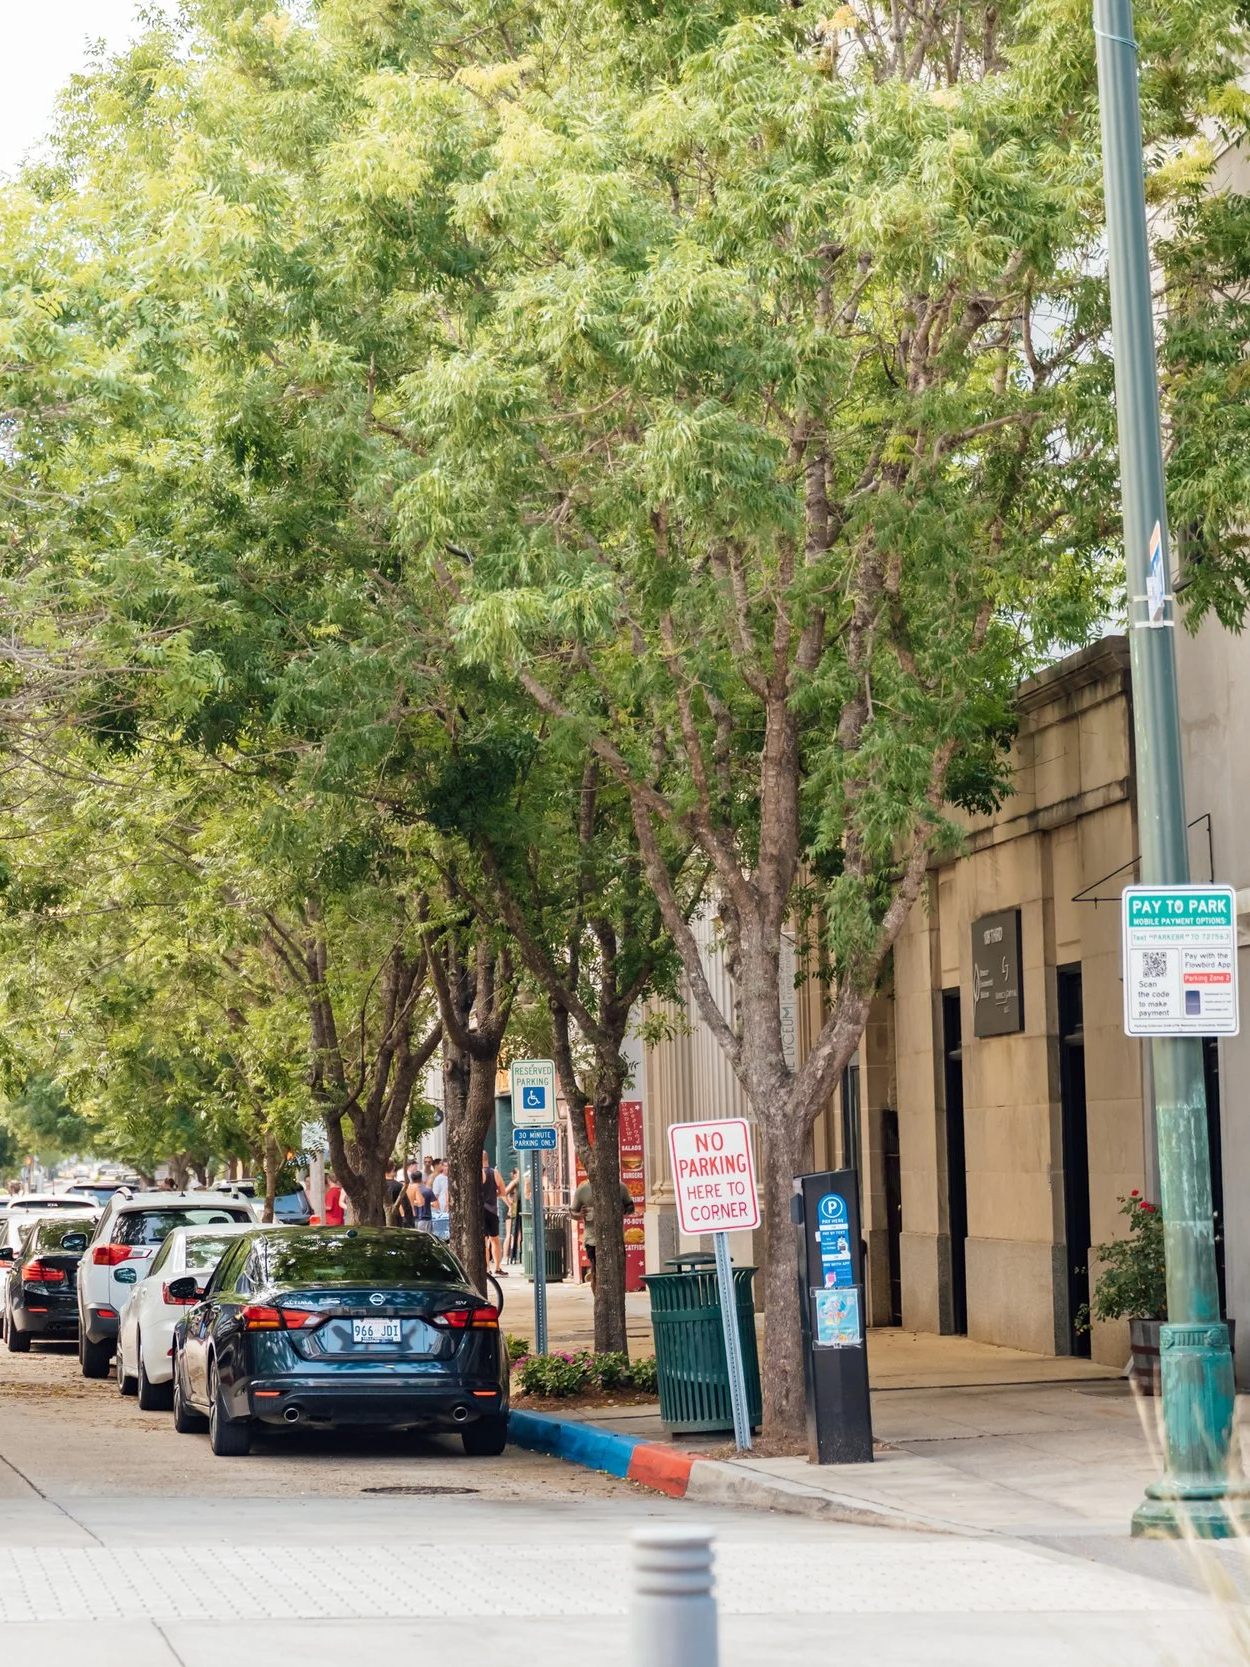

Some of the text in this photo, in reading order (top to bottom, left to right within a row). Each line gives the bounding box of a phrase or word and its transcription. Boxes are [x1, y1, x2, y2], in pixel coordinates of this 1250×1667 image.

[1133, 899, 1227, 914] PAY TO PARK
[1133, 918, 1159, 926] MOBILE
[1160, 917, 1194, 925] PAYMENT
[1184, 952, 1198, 960] Pay
[1184, 961, 1232, 969] Flowbird App
[1138, 980, 1158, 988] Scan
[1138, 1010, 1170, 1018] payment
[781, 1005, 795, 1056] LYCEUM
[514, 1066, 552, 1076] RESERVED
[516, 1078, 549, 1086] PARKING
[519, 1131, 551, 1139] 30 MINUTE
[514, 1139, 539, 1147] PARKING
[695, 1131, 724, 1153] NO
[678, 1153, 747, 1179] PARKING
[686, 1181, 746, 1201] HERE TO
[690, 1201, 748, 1222] CORNER
[827, 1200, 838, 1215] P
[354, 1325, 399, 1337] 966 JDI
